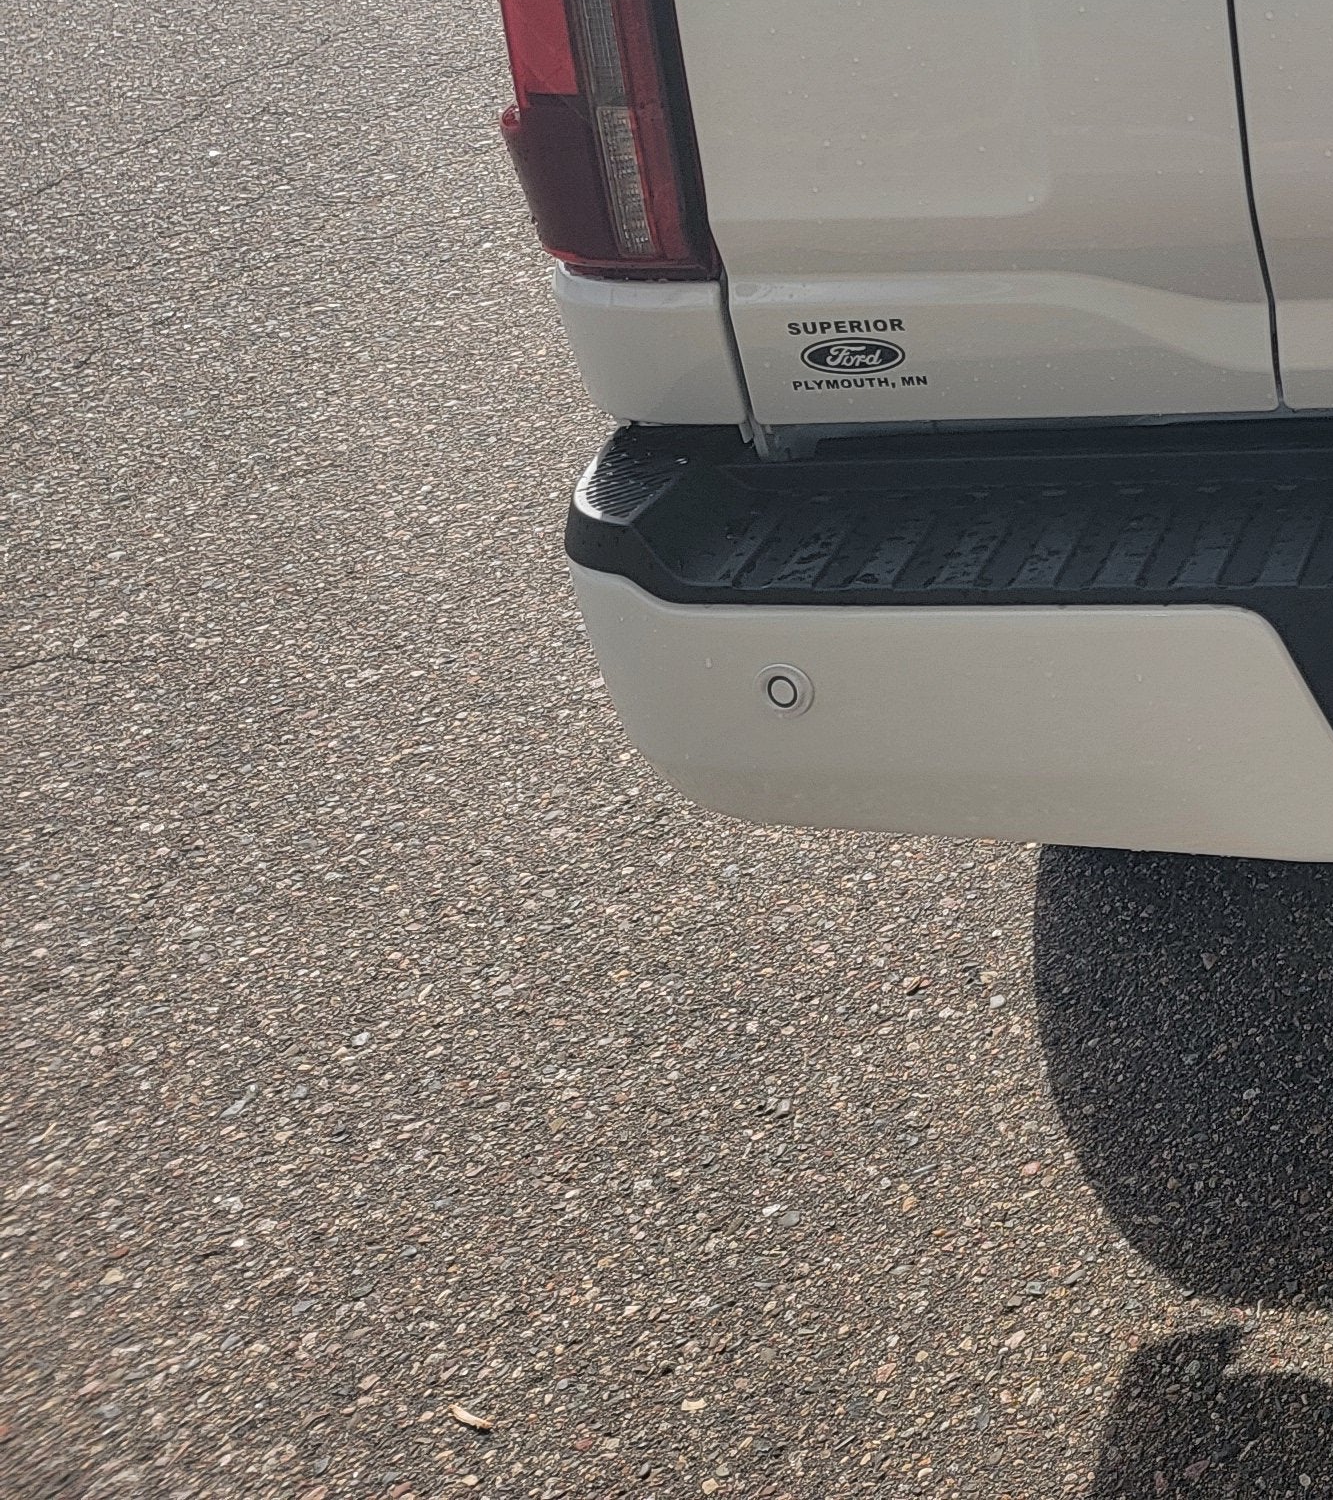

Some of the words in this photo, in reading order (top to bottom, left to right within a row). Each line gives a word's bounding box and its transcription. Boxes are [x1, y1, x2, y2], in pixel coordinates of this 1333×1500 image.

[787, 318, 905, 335] SUPERIOR
[826, 345, 882, 366] Ford
[792, 377, 896, 390] PLYMOUTH,
[901, 375, 928, 386] MN
